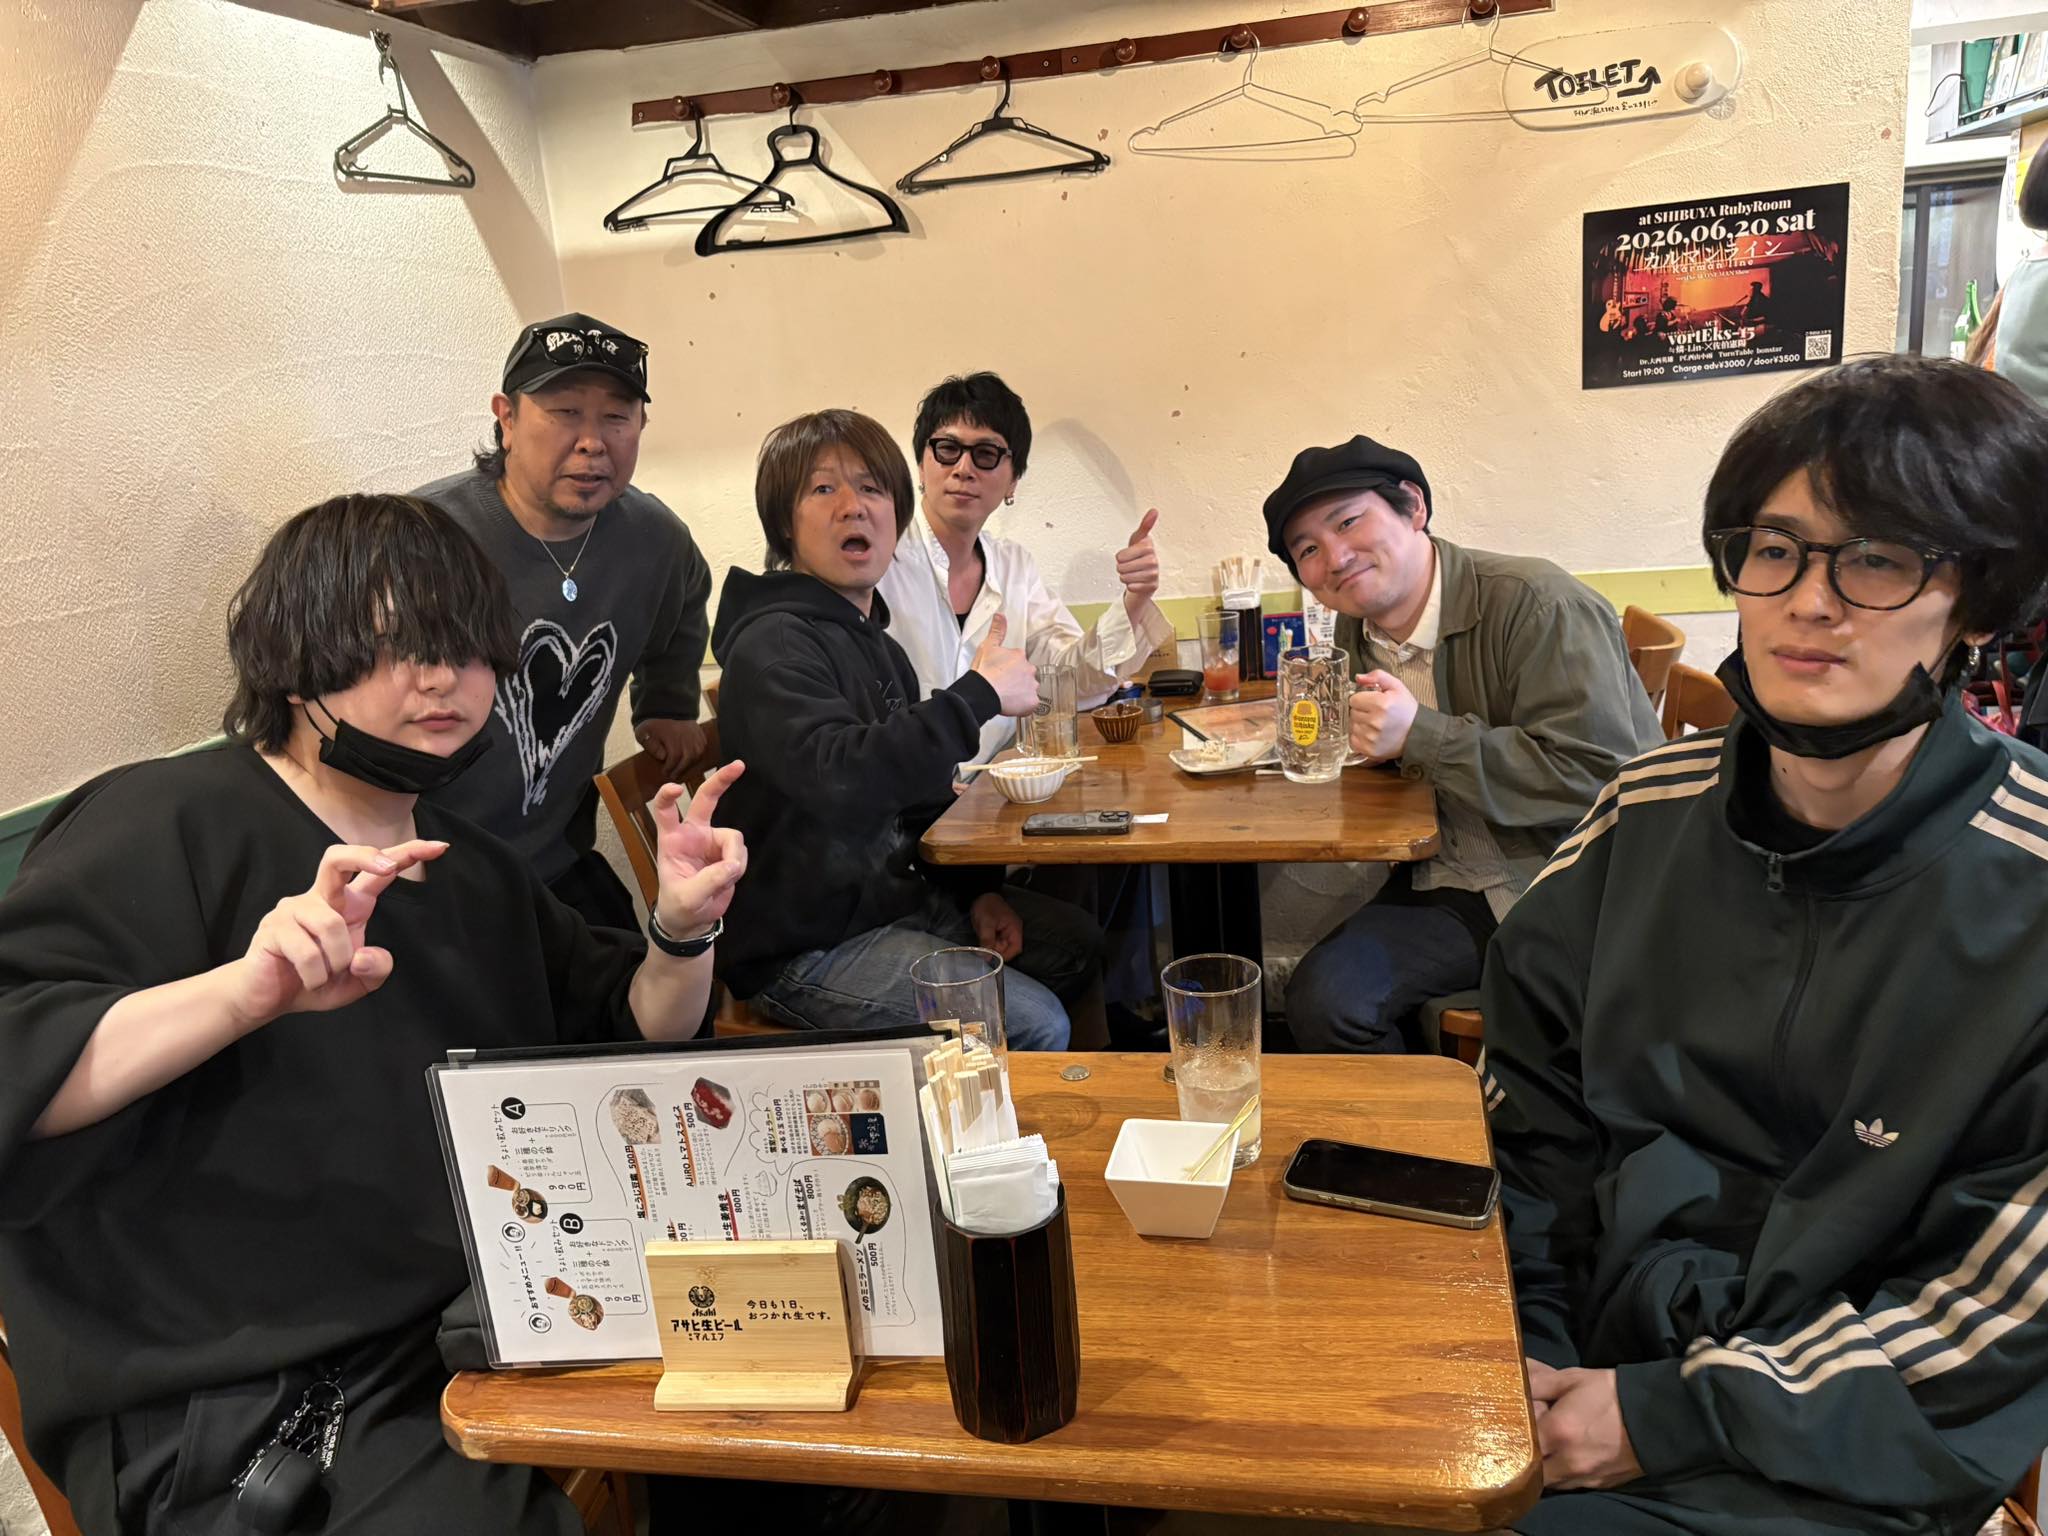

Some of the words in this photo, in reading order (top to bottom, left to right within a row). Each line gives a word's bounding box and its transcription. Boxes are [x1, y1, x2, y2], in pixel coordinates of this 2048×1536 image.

[1534, 59, 1642, 102] TOILET
[1638, 213, 1652, 226] at
[1653, 206, 1717, 225] SHIBUYA
[1719, 199, 1792, 217] RubyRoom
[1776, 208, 1817, 232] sat
[1622, 369, 1642, 378] Start
[1643, 366, 1665, 376] 19:00
[1672, 364, 1703, 375] Charge
[683, 1102, 695, 1128] 500円
[773, 1098, 784, 1121] 500円
[672, 1105, 689, 1160] トマトスライス
[624, 1145, 637, 1169] 500円
[548, 1182, 587, 1191] 990円
[804, 1174, 815, 1200] 800円
[731, 1189, 743, 1213] 800円
[793, 1178, 808, 1240] とくるみのまぜそば
[868, 1242, 879, 1267] 500円
[604, 1294, 642, 1303] 990円
[670, 1319, 743, 1332] アサヒ生ビール
[749, 1311, 832, 1321] おつかれ生です。
